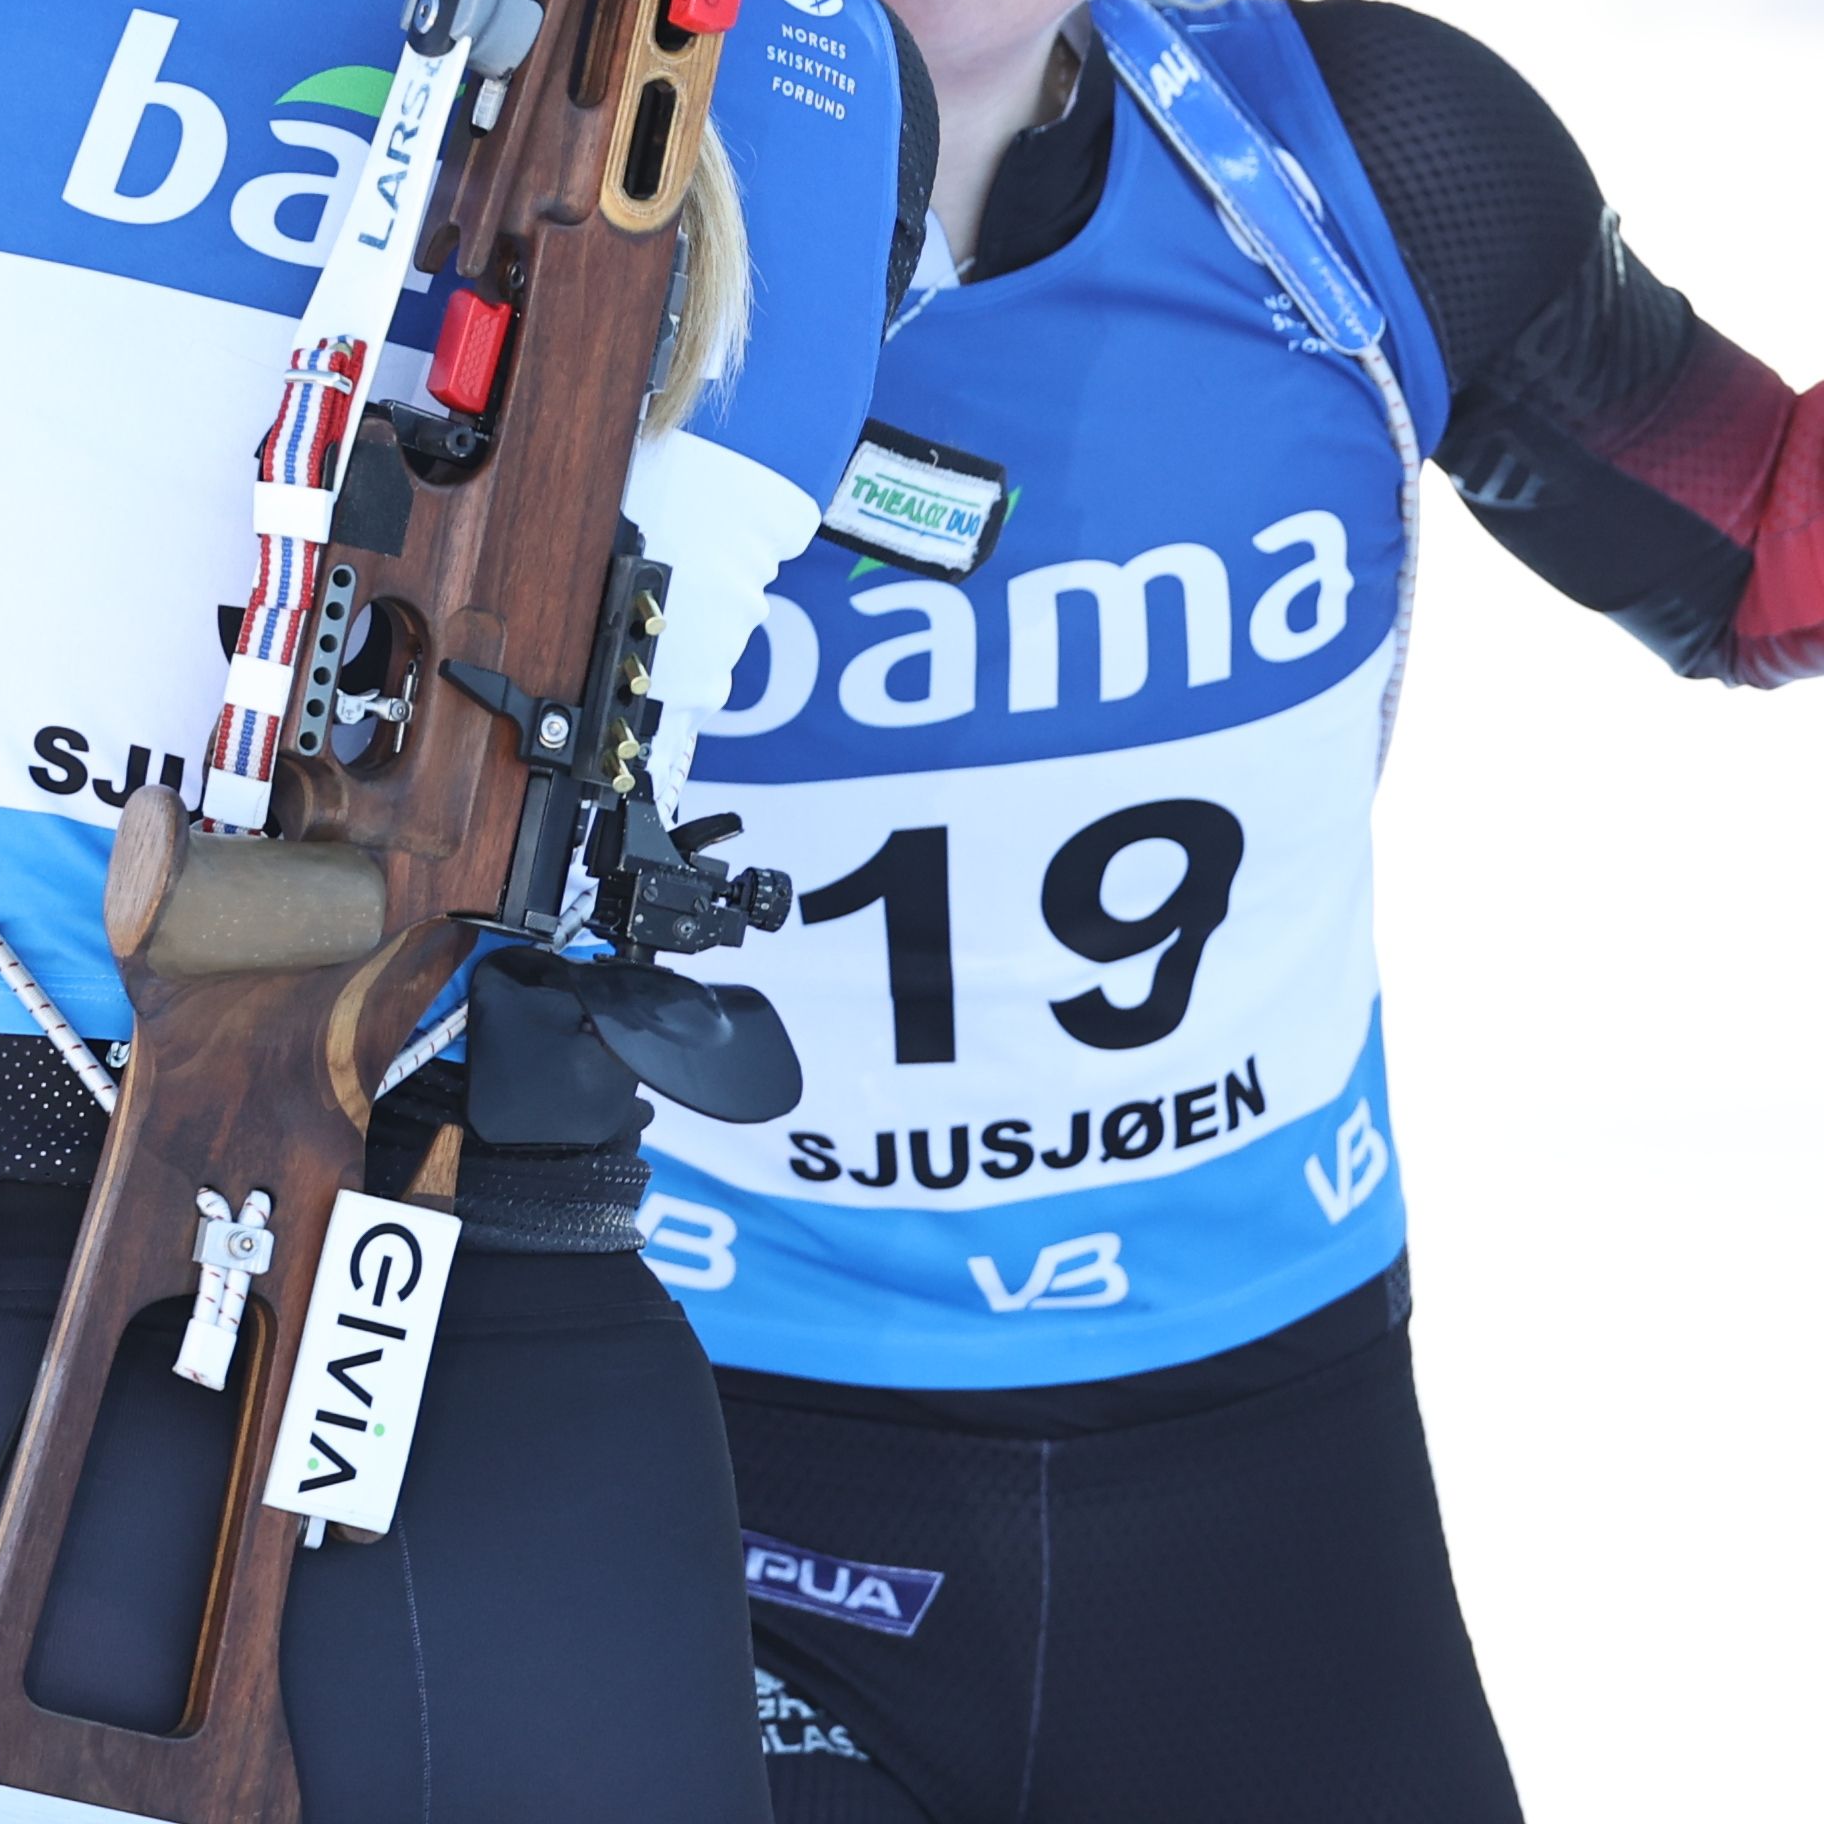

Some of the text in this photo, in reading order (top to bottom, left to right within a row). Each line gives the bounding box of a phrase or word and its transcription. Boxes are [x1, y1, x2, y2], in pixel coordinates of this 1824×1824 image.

[766, 44, 856, 96] SKISKYTTER
[781, 23, 847, 60] NORGES
[61, 7, 372, 268] ba
[772, 75, 846, 121] FORBUND
[797, 796, 1246, 1064] 19
[788, 1053, 1268, 1190] SJUSJØEN
[637, 1191, 738, 1291] B
[745, 1546, 903, 1619] PUA
